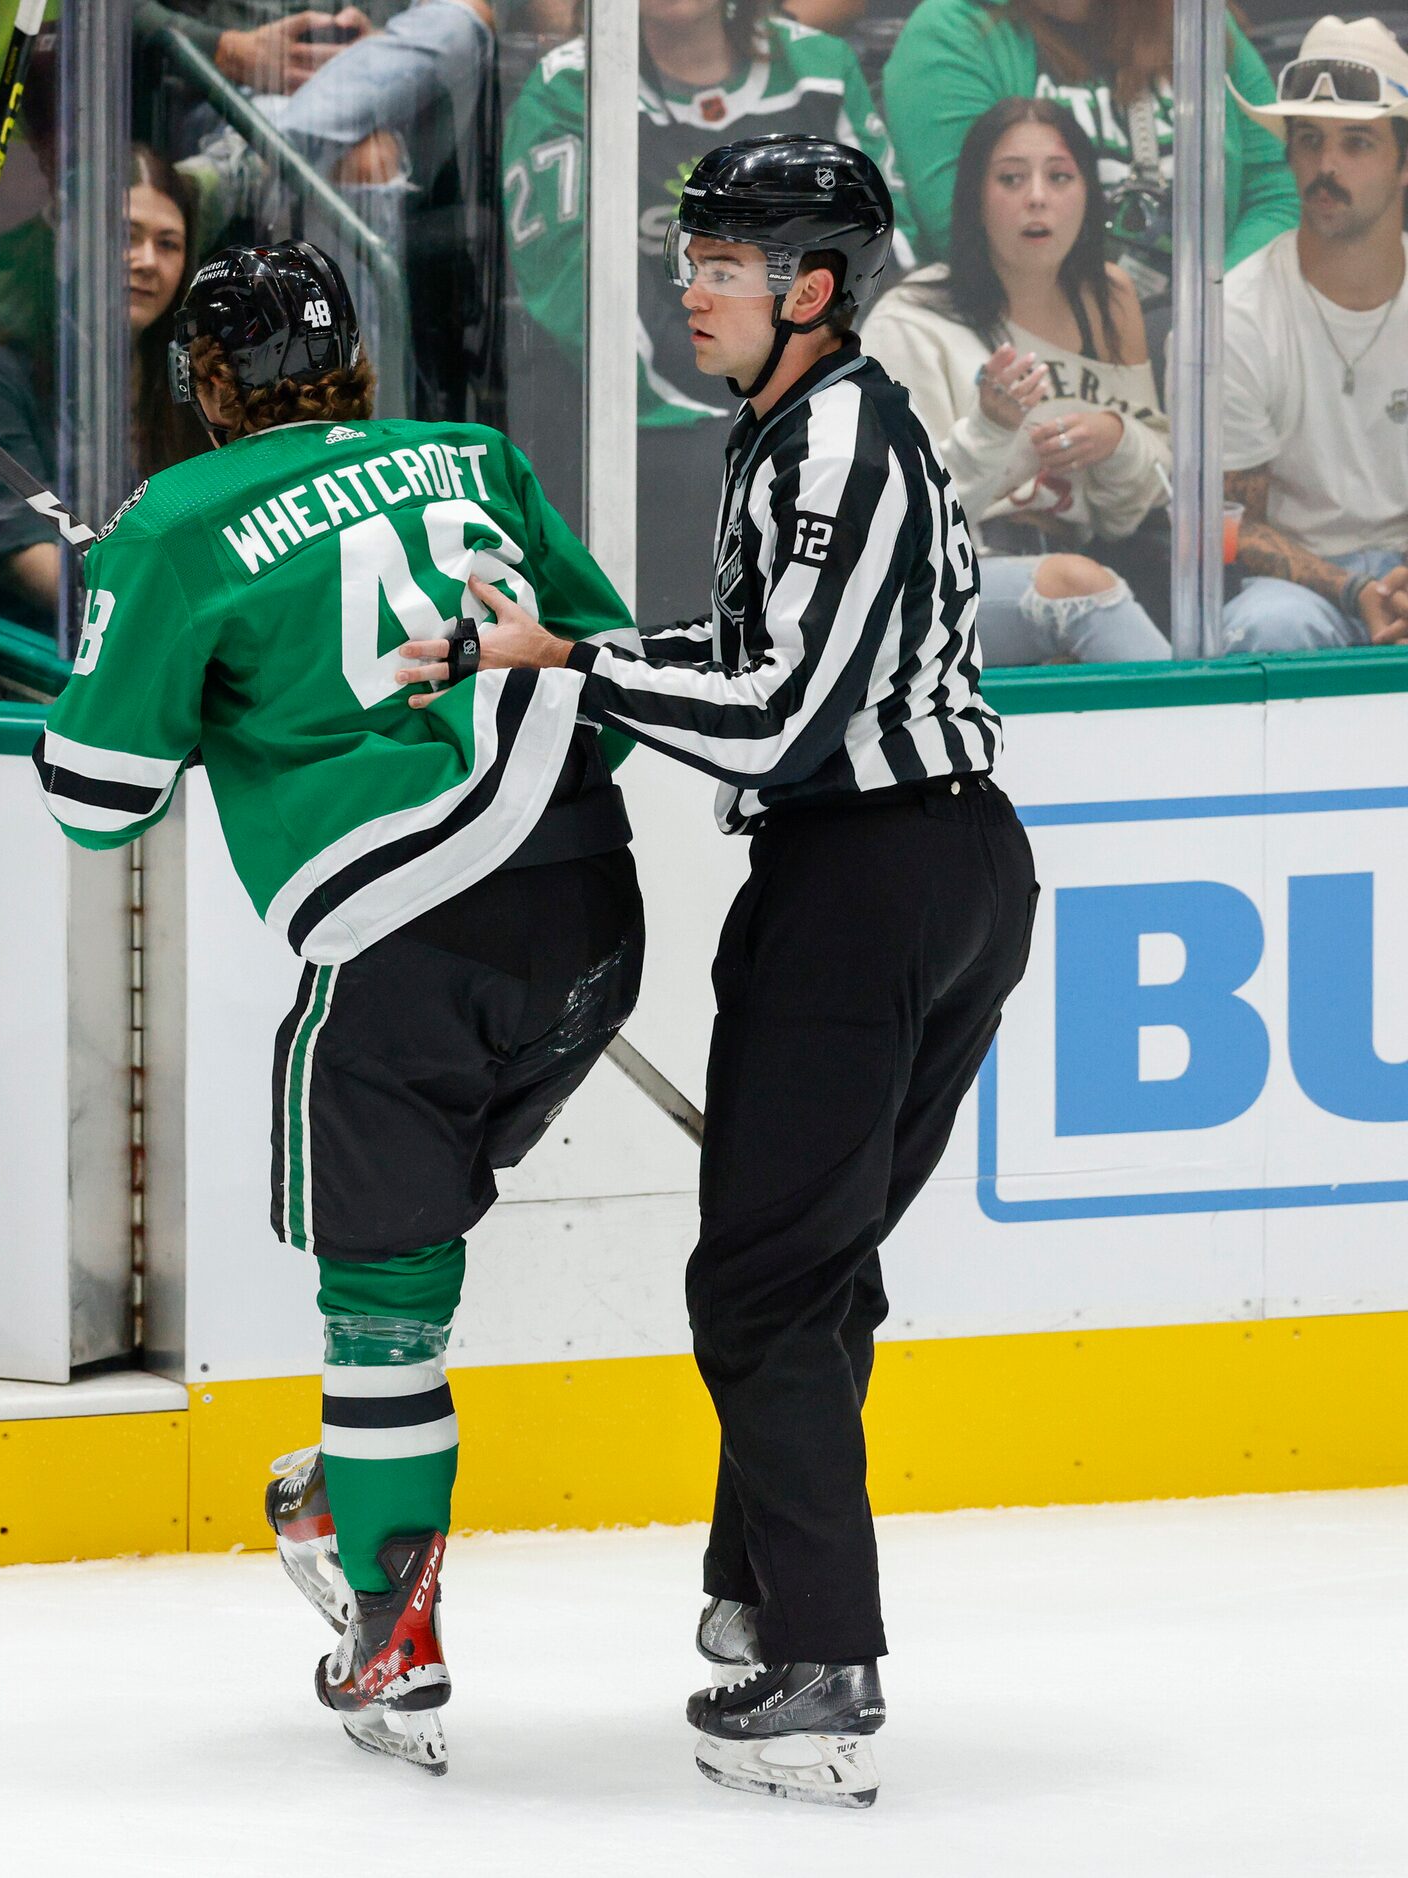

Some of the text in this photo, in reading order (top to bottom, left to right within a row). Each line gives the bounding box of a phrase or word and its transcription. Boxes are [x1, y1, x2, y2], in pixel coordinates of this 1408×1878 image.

[503, 134, 583, 251] 27
[303, 299, 332, 328] 48
[325, 429, 367, 445] adidas
[222, 443, 491, 575] WHEATCROFT
[412, 1545, 440, 1613] CCM
